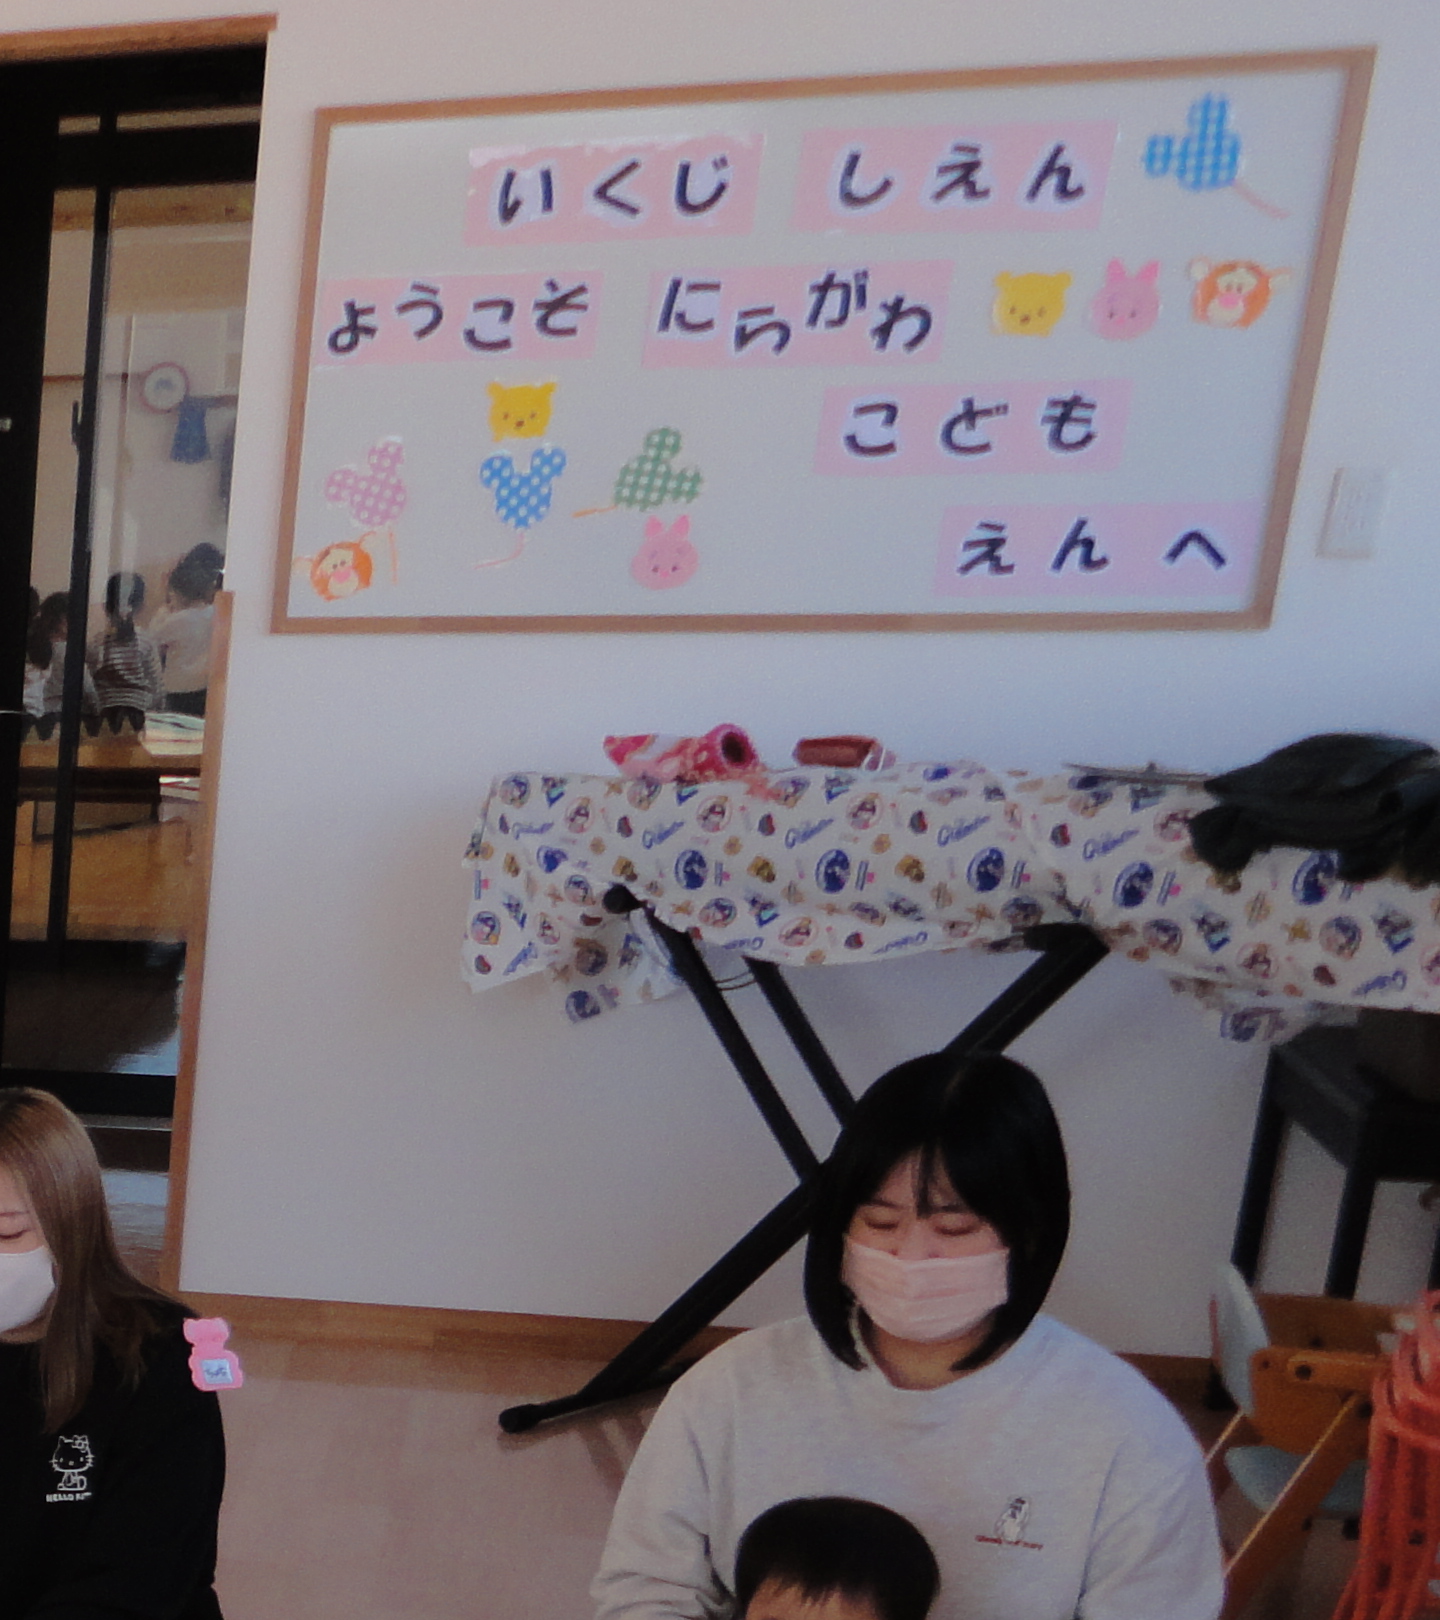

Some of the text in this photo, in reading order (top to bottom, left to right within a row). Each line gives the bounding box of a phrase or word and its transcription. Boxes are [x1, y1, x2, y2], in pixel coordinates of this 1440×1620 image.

[498, 145, 1086, 225] いくじ しえん
[327, 270, 933, 355] ようこそ にらがわ
[843, 394, 1099, 457] こども
[957, 520, 1227, 575] えんへ
